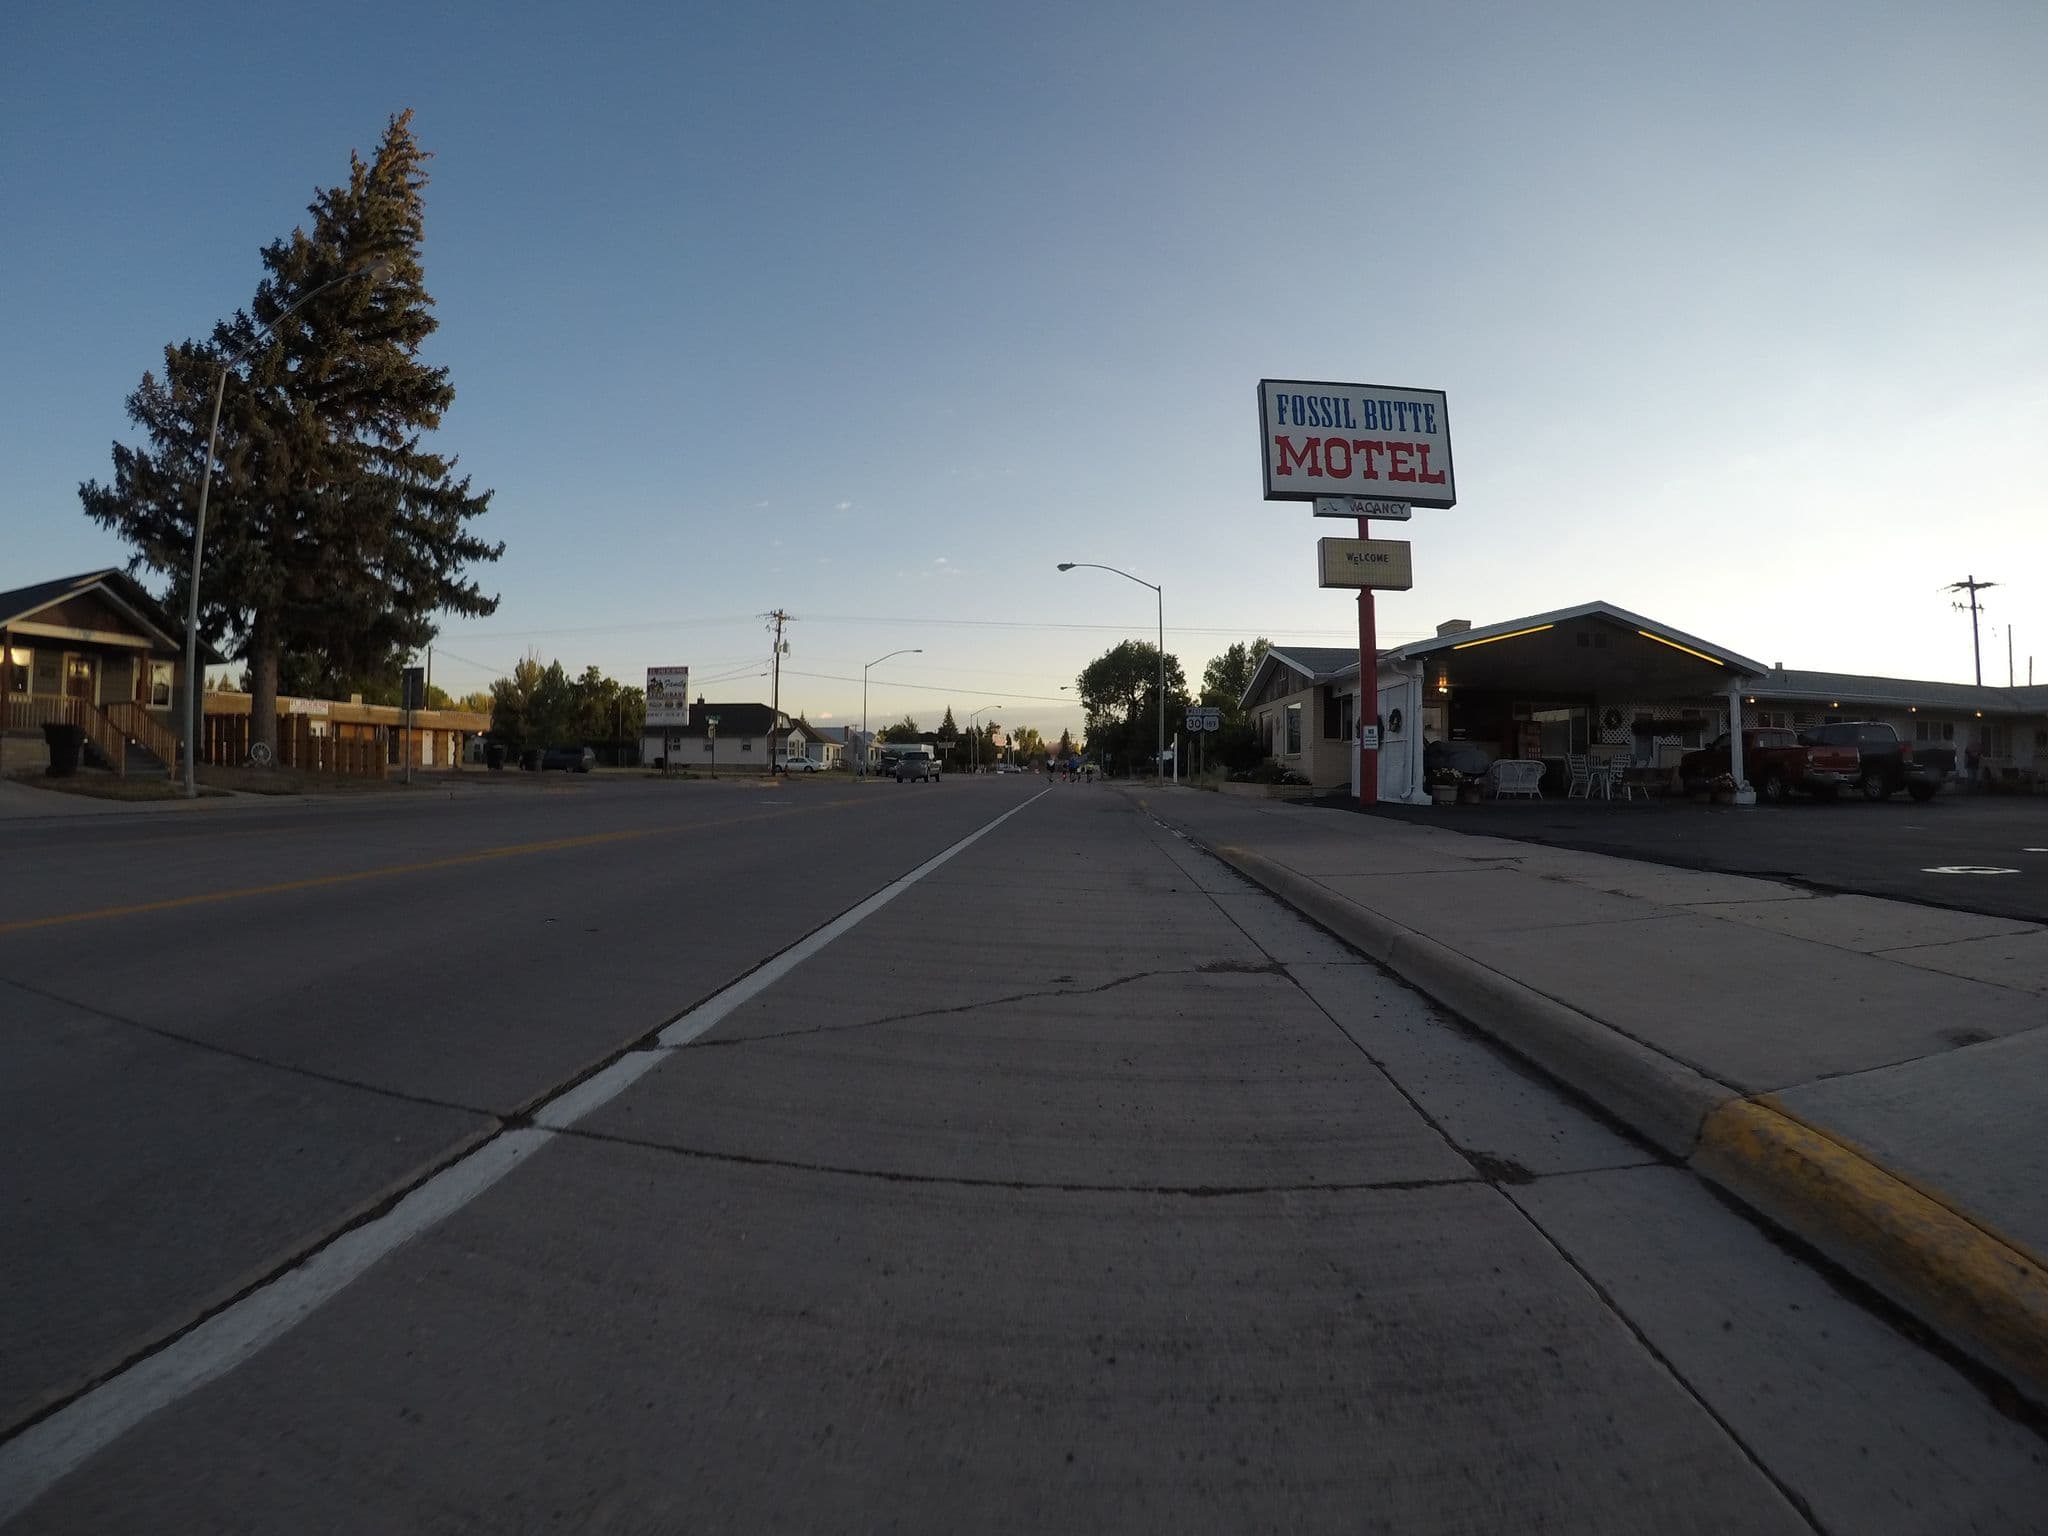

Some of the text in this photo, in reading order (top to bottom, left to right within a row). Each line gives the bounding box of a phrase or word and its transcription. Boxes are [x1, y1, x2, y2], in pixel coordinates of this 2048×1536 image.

[1276, 394, 1437, 434] FOSSIL BUTTE
[1275, 435, 1446, 485] MOTEL
[1350, 501, 1406, 515] VACANCY
[1346, 552, 1389, 565] WELCOME
[1189, 719, 1201, 729] 30
